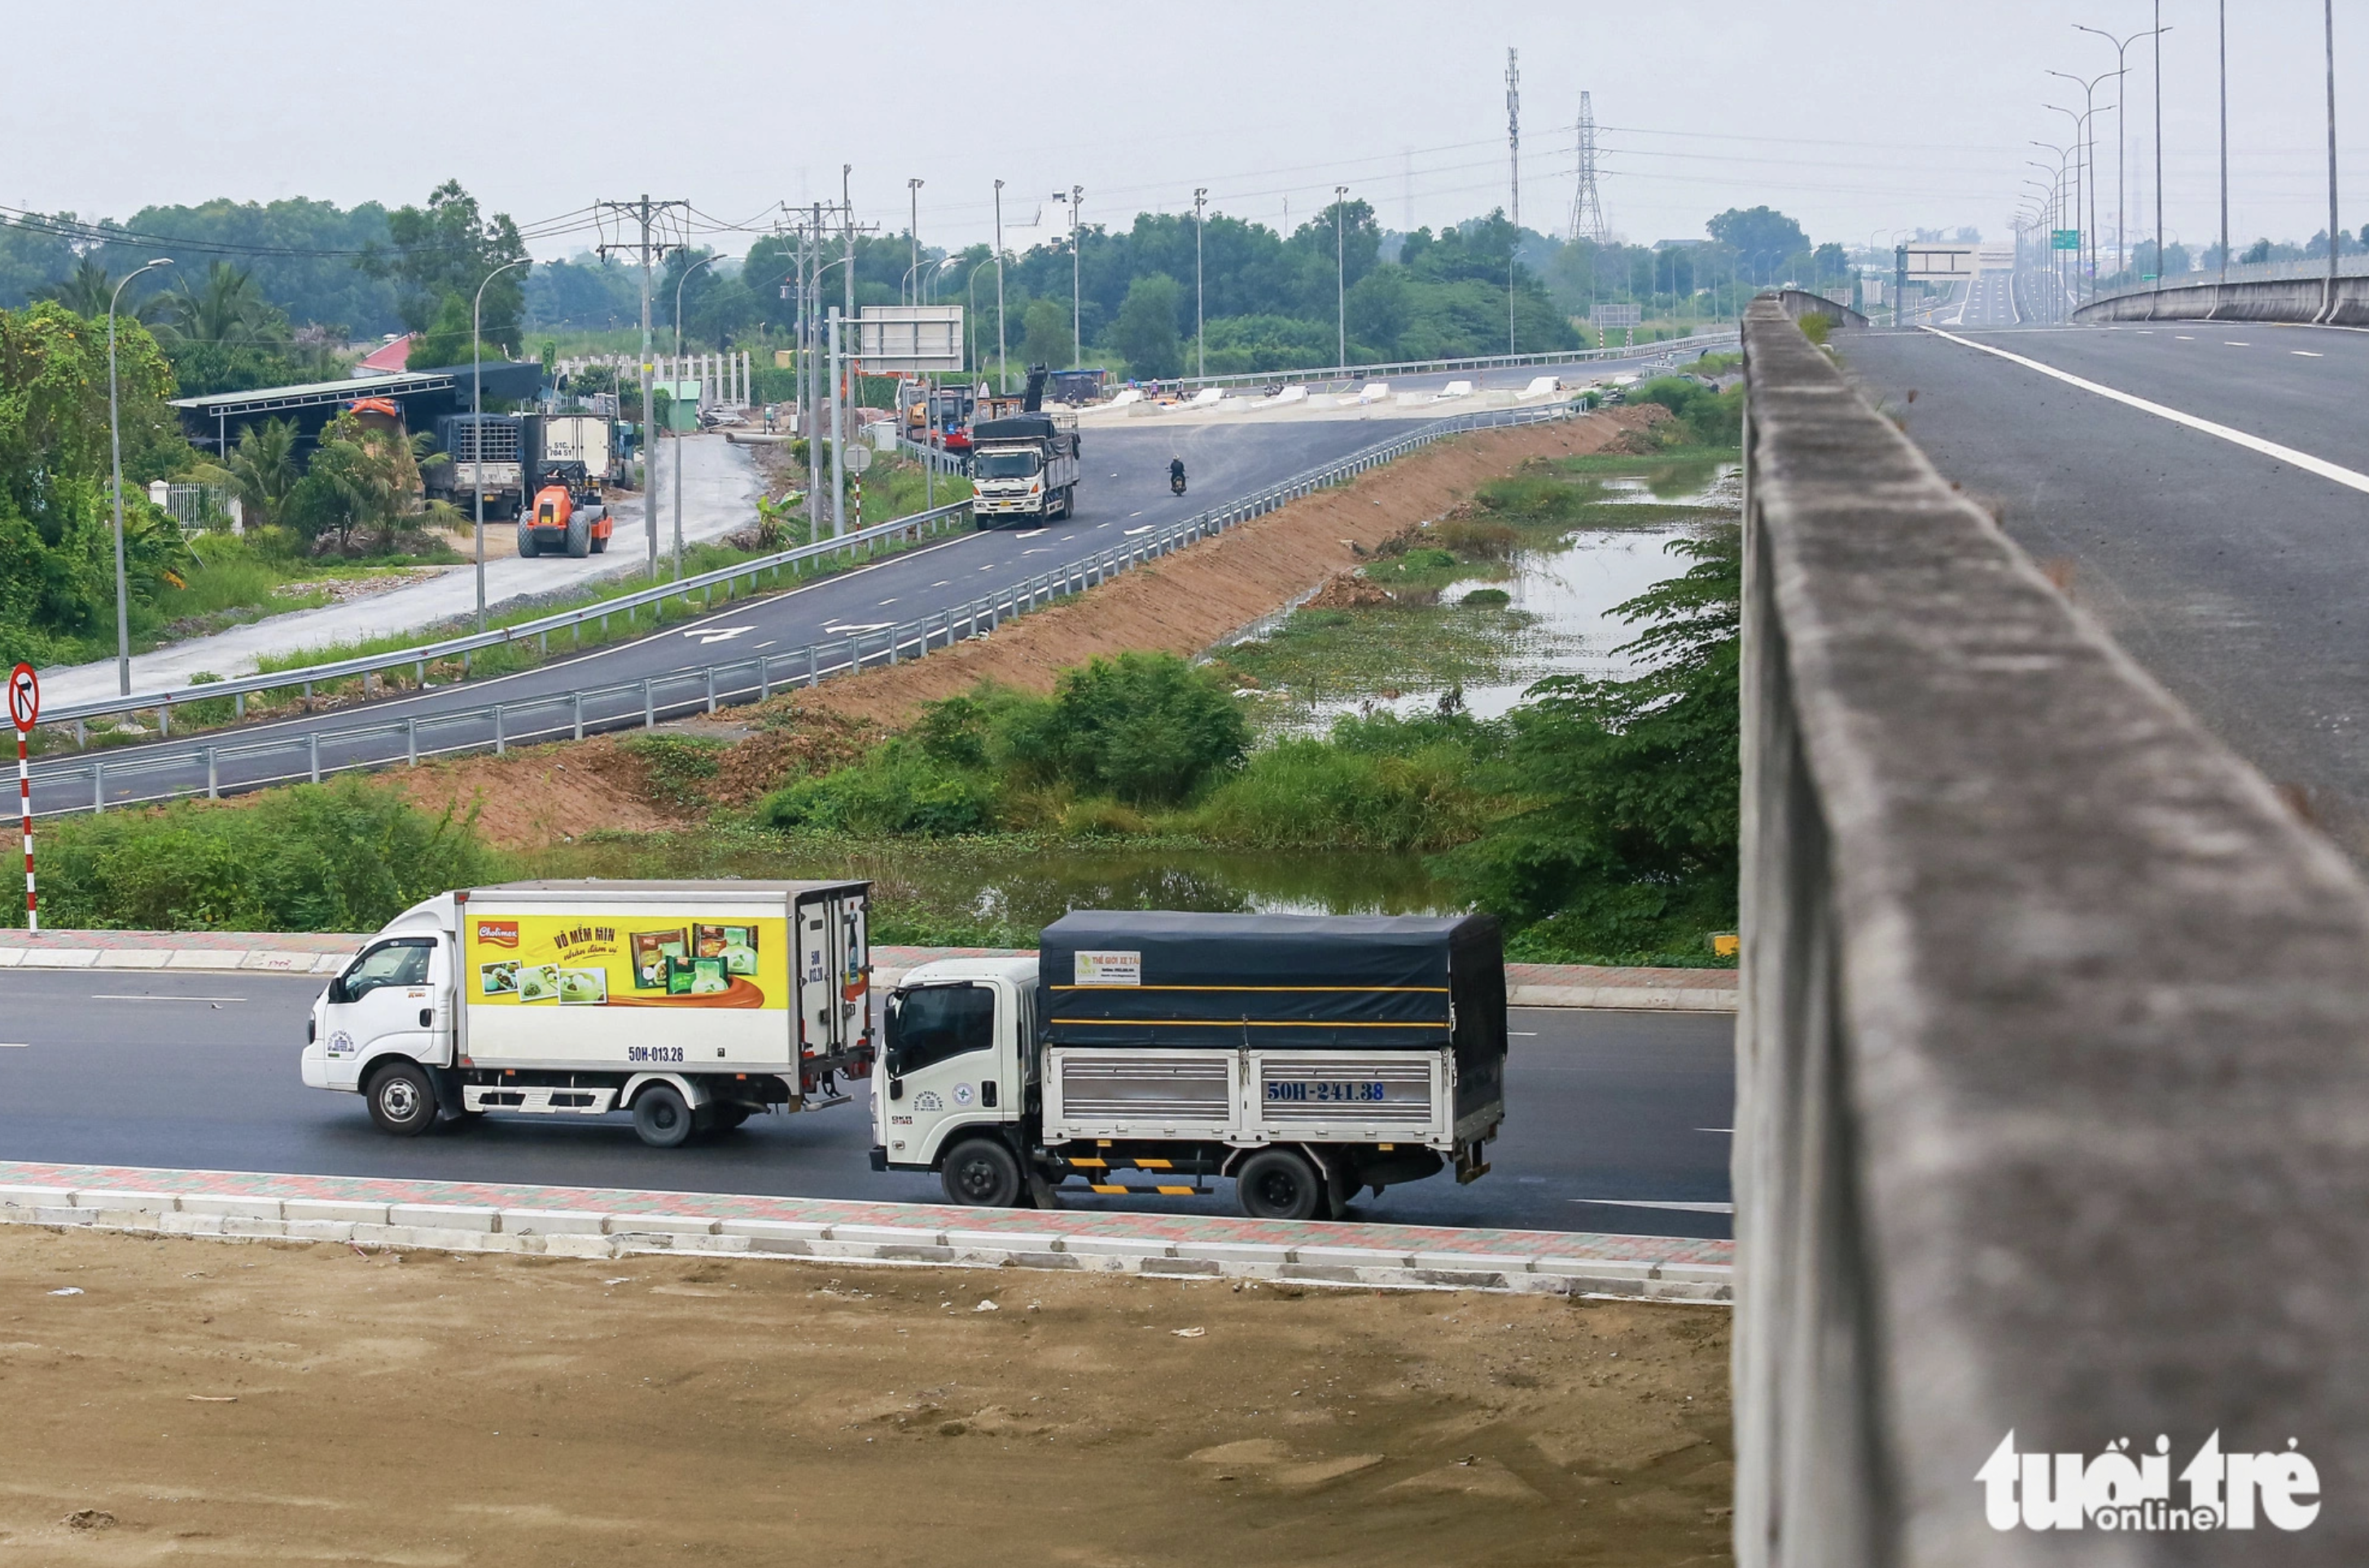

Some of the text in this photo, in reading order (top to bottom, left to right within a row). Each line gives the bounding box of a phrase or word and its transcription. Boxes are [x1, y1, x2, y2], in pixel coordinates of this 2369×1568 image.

[479, 926, 518, 937] Cholimex
[554, 924, 615, 948] VỎ MỀM MỊN
[1119, 956, 1128, 965] XE
[628, 1046, 684, 1062] 50H-013.28
[1268, 1082, 1384, 1101] 50H-241.38
